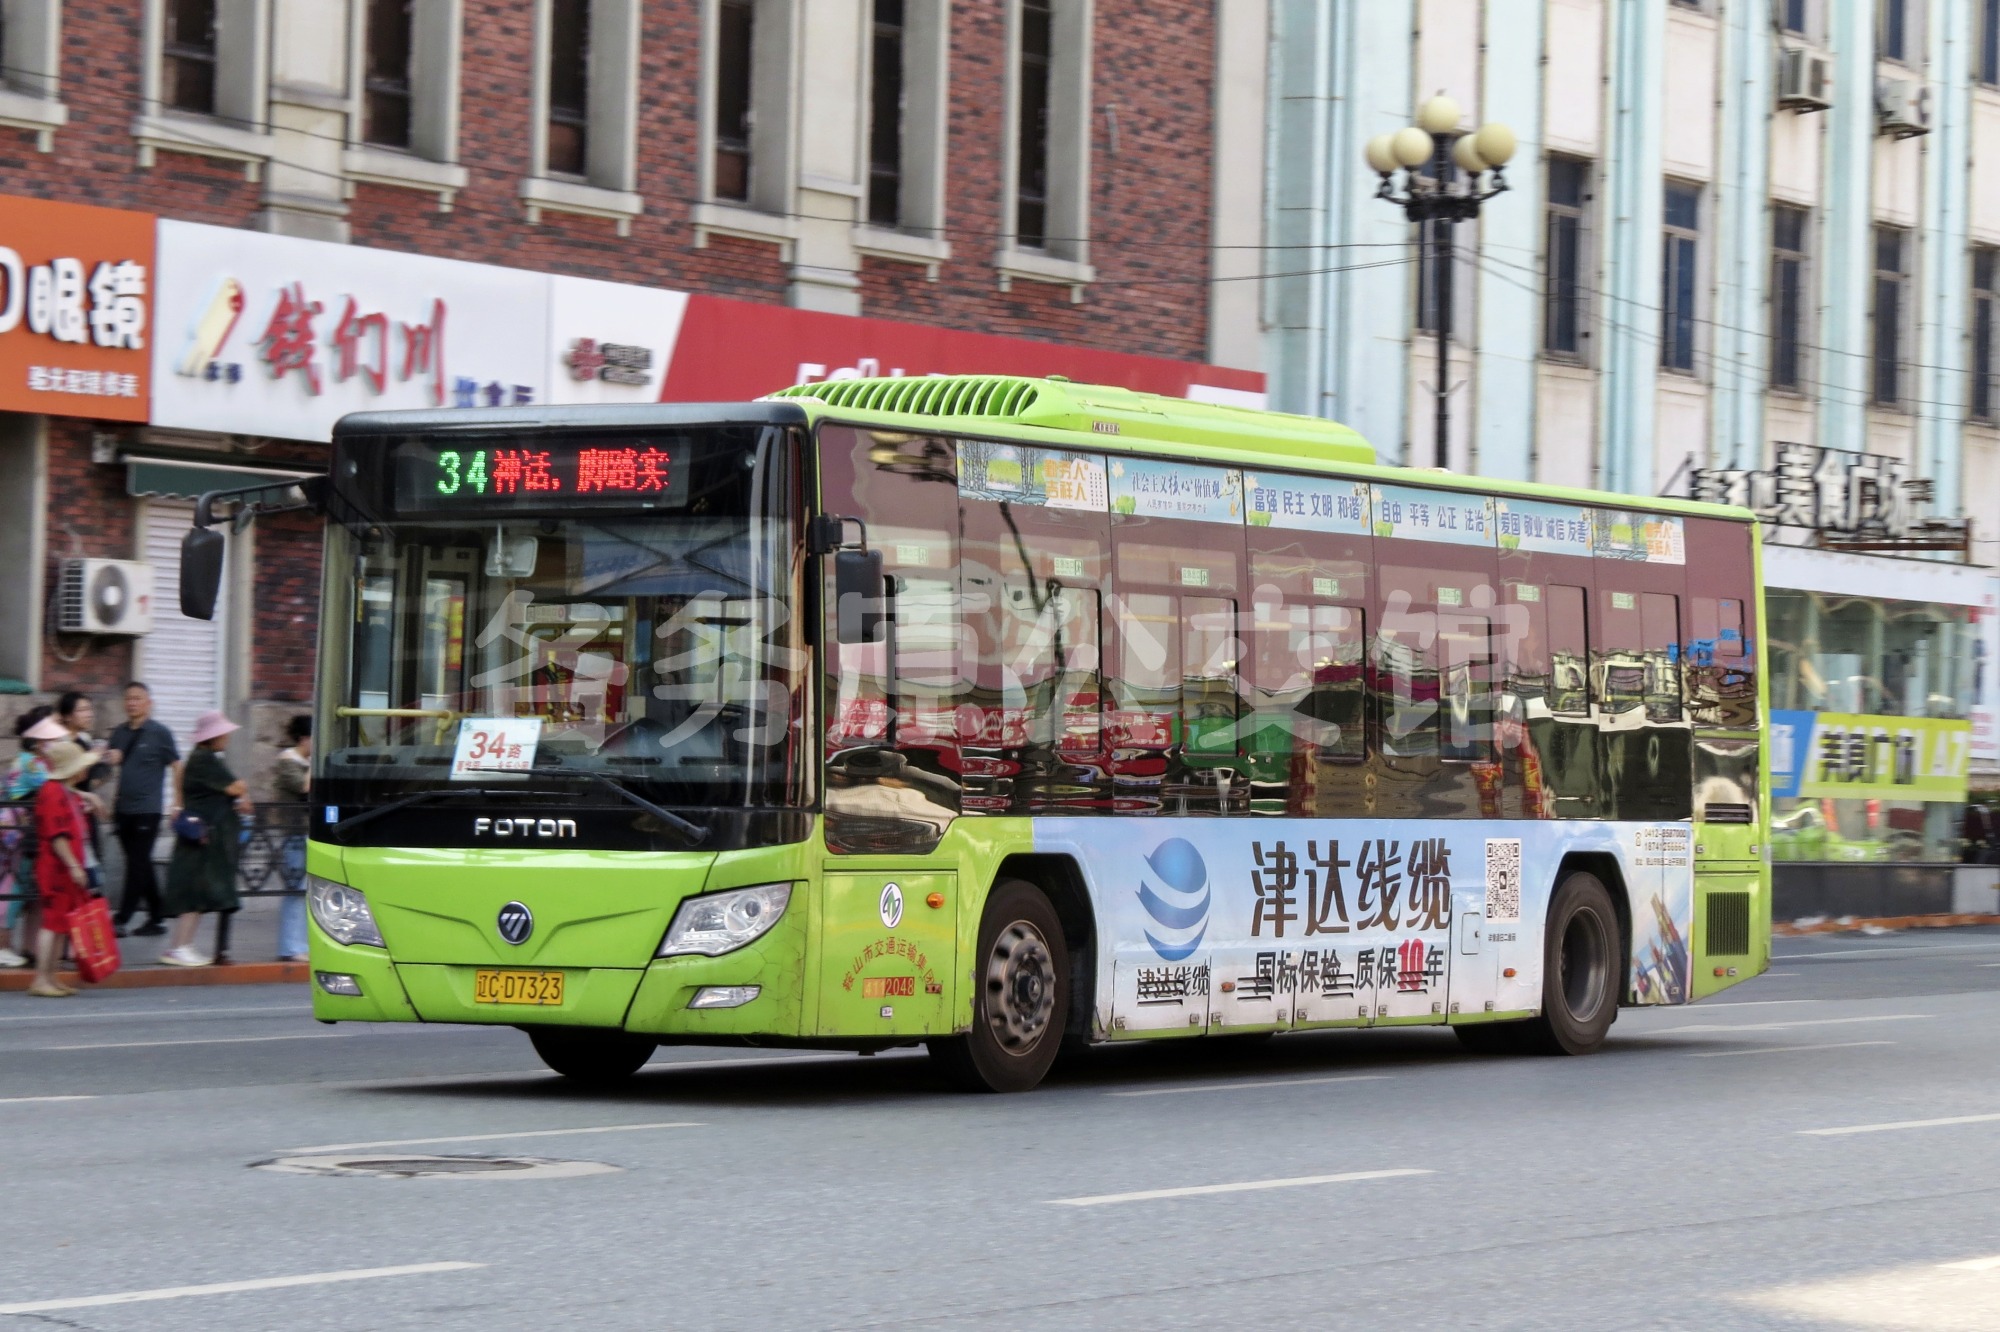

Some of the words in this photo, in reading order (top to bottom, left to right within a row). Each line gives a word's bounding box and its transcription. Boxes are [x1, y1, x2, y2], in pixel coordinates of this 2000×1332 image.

[438, 450, 488, 493] 34
[1132, 471, 1221, 499] 社会主义核心价值观
[1254, 487, 1278, 513] 富强
[1283, 490, 1306, 516] 民主
[1311, 492, 1333, 518] 文明
[1338, 495, 1360, 521] 和谐
[1381, 500, 1402, 525] 自由
[1409, 502, 1430, 528] 平等
[1437, 505, 1457, 530] 公正
[1464, 508, 1484, 533] 法治
[1501, 512, 1521, 536] 爱国
[1524, 514, 1543, 538] 敬业
[1546, 515, 1565, 541] 诚信
[1567, 518, 1586, 543] 友善
[474, 817, 577, 838] FOTON
[1250, 837, 1452, 938] 津达线缆
[842, 936, 936, 992] 鞍山市交通运输集团
